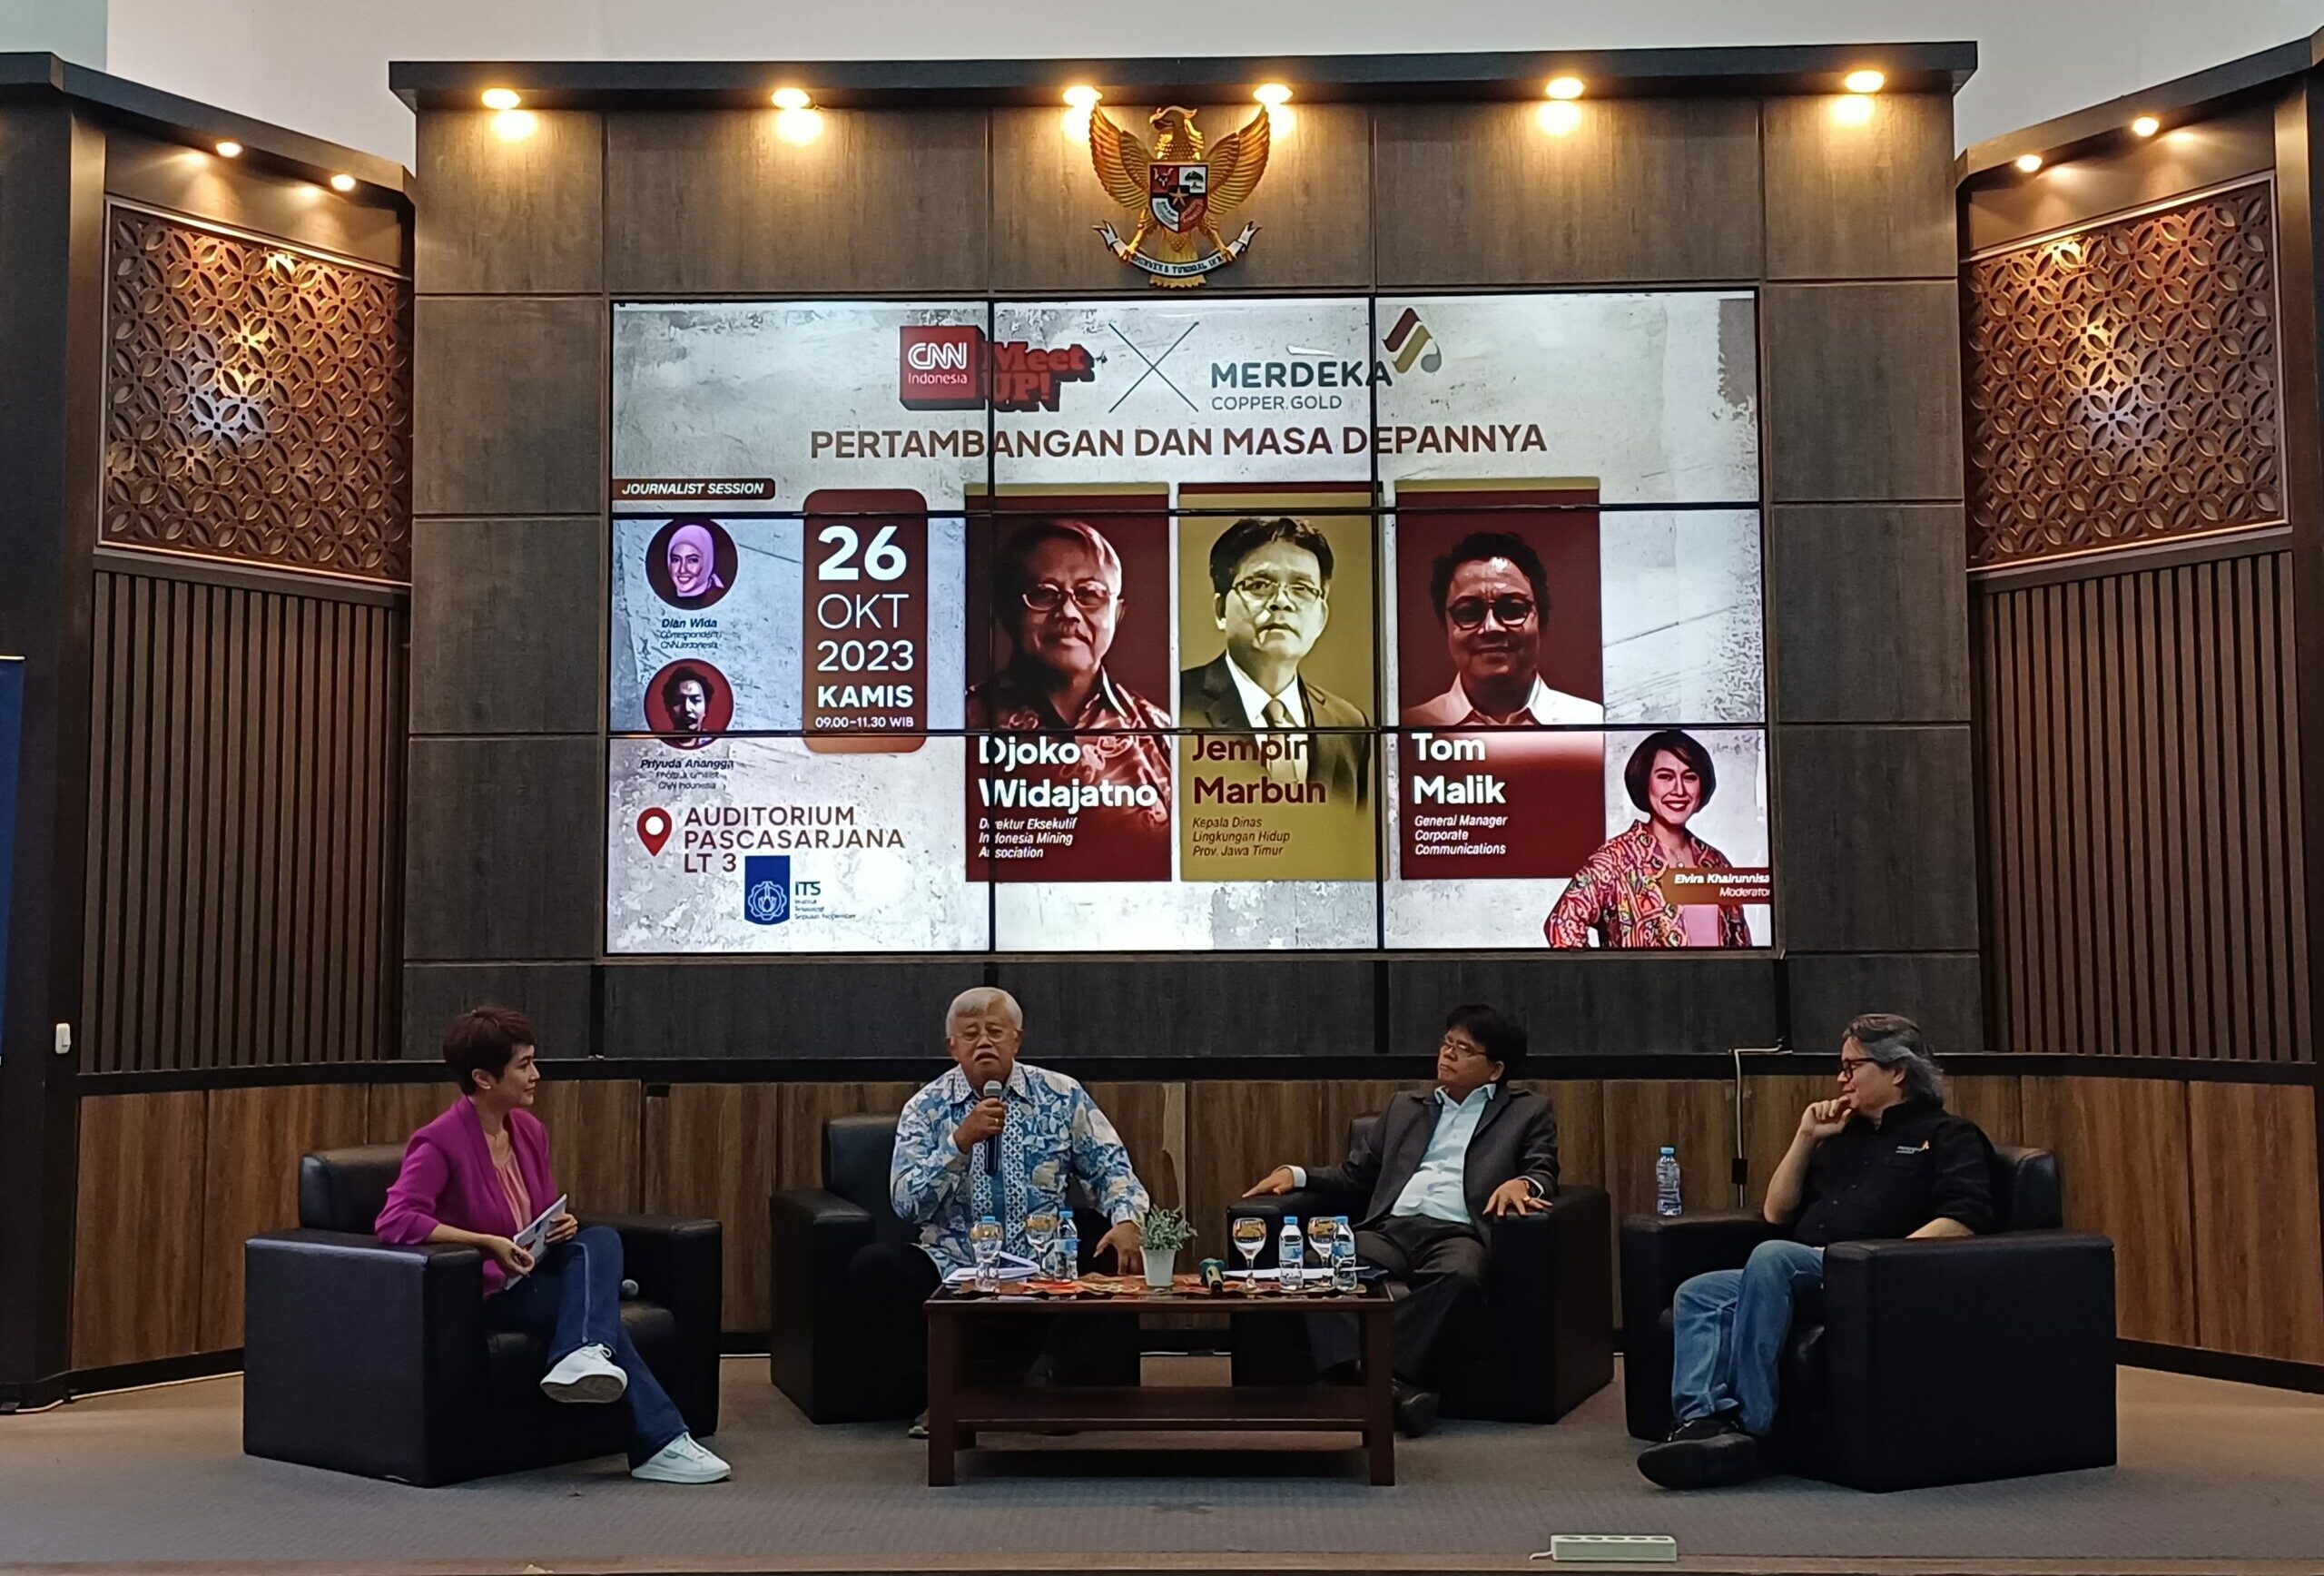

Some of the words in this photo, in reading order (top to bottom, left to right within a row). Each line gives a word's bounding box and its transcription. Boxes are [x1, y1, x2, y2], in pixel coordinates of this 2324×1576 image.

[908, 342, 967, 369] CNN
[981, 341, 1086, 371] Meet
[908, 373, 967, 385] Indonesia
[1212, 360, 1393, 389] MERDEKA
[981, 371, 1051, 401] UP!
[811, 429, 1123, 458] PERTAMBANGAN
[1135, 428, 1212, 457] DAN
[1224, 426, 1333, 456] MASA
[1343, 424, 1547, 454] DEPANNYA
[622, 483, 705, 495] JOURNALIST
[707, 483, 764, 495] SESSION
[818, 526, 907, 581] 26
[817, 594, 910, 629] OKT
[661, 618, 686, 628] Dian
[690, 618, 717, 628] Wida
[817, 640, 913, 672] 2023
[818, 685, 913, 708] KAMIS
[889, 716, 914, 727] WIB
[979, 735, 1081, 772] Djoko
[1192, 734, 1312, 767] Jempin
[1411, 733, 1486, 761] Tom
[979, 778, 1158, 814] Widajatno
[1194, 776, 1326, 803] Marbun
[1413, 774, 1507, 804] Malik
[684, 806, 854, 827] AUDITORIUM
[980, 817, 1025, 830] Dektur
[1027, 817, 1078, 830] Eksekutif
[1192, 817, 1229, 830] Kepala
[1232, 816, 1263, 828] Dinas
[1414, 814, 1458, 827] General
[1459, 814, 1508, 829] Manager
[684, 829, 905, 850] PASCASARJANA
[1037, 832, 1074, 846] Mining
[1193, 831, 1256, 844] Lingkungan
[1258, 831, 1291, 843] Hidup
[1414, 829, 1469, 842] Corporate
[1221, 845, 1250, 857] Jawa
[1253, 844, 1284, 856] Timur
[1415, 842, 1507, 855] Communications
[684, 853, 712, 873] LT
[722, 852, 737, 872] 3
[795, 881, 821, 895] ITS
[1674, 873, 1705, 884] Elvira
